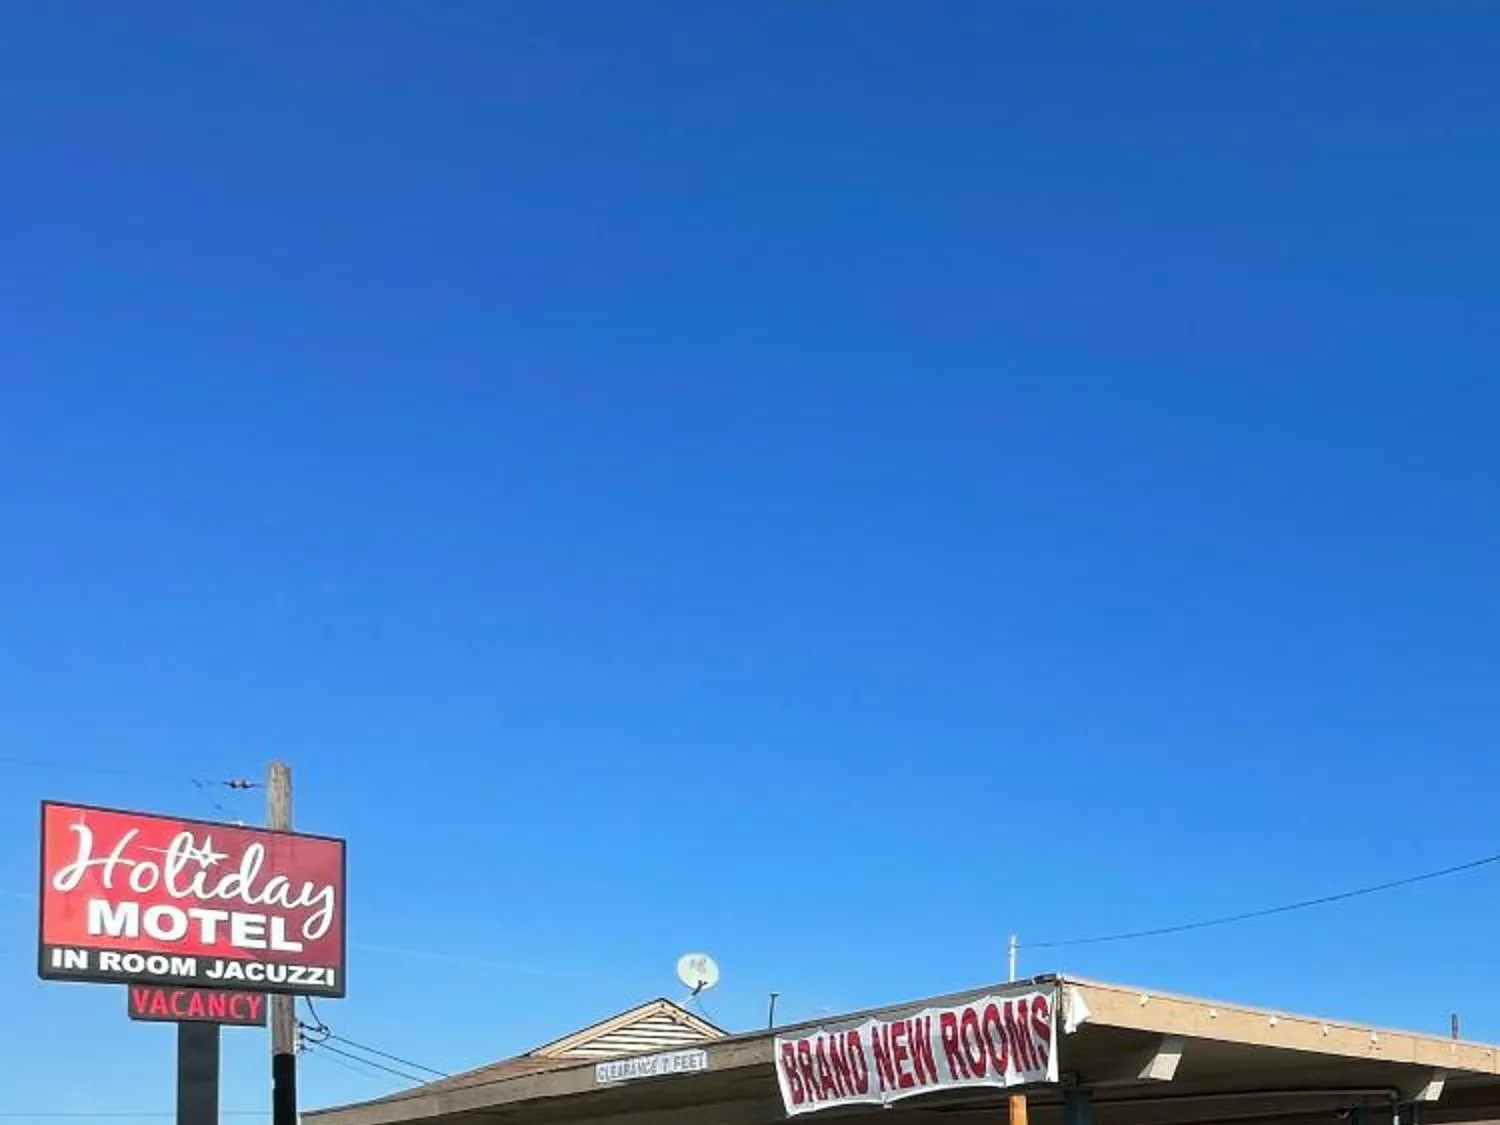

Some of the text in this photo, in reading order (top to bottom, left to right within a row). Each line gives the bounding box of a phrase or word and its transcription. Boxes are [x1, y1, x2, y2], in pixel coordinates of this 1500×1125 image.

[53, 824, 335, 941] Holiday
[88, 899, 303, 952] MOTEL
[51, 948, 335, 986] IN ROOM JACUZZI
[131, 988, 262, 1019] VACANCY
[673, 1052, 706, 1072] FEET
[781, 995, 1051, 1104] BRAND NEW ROOMS
